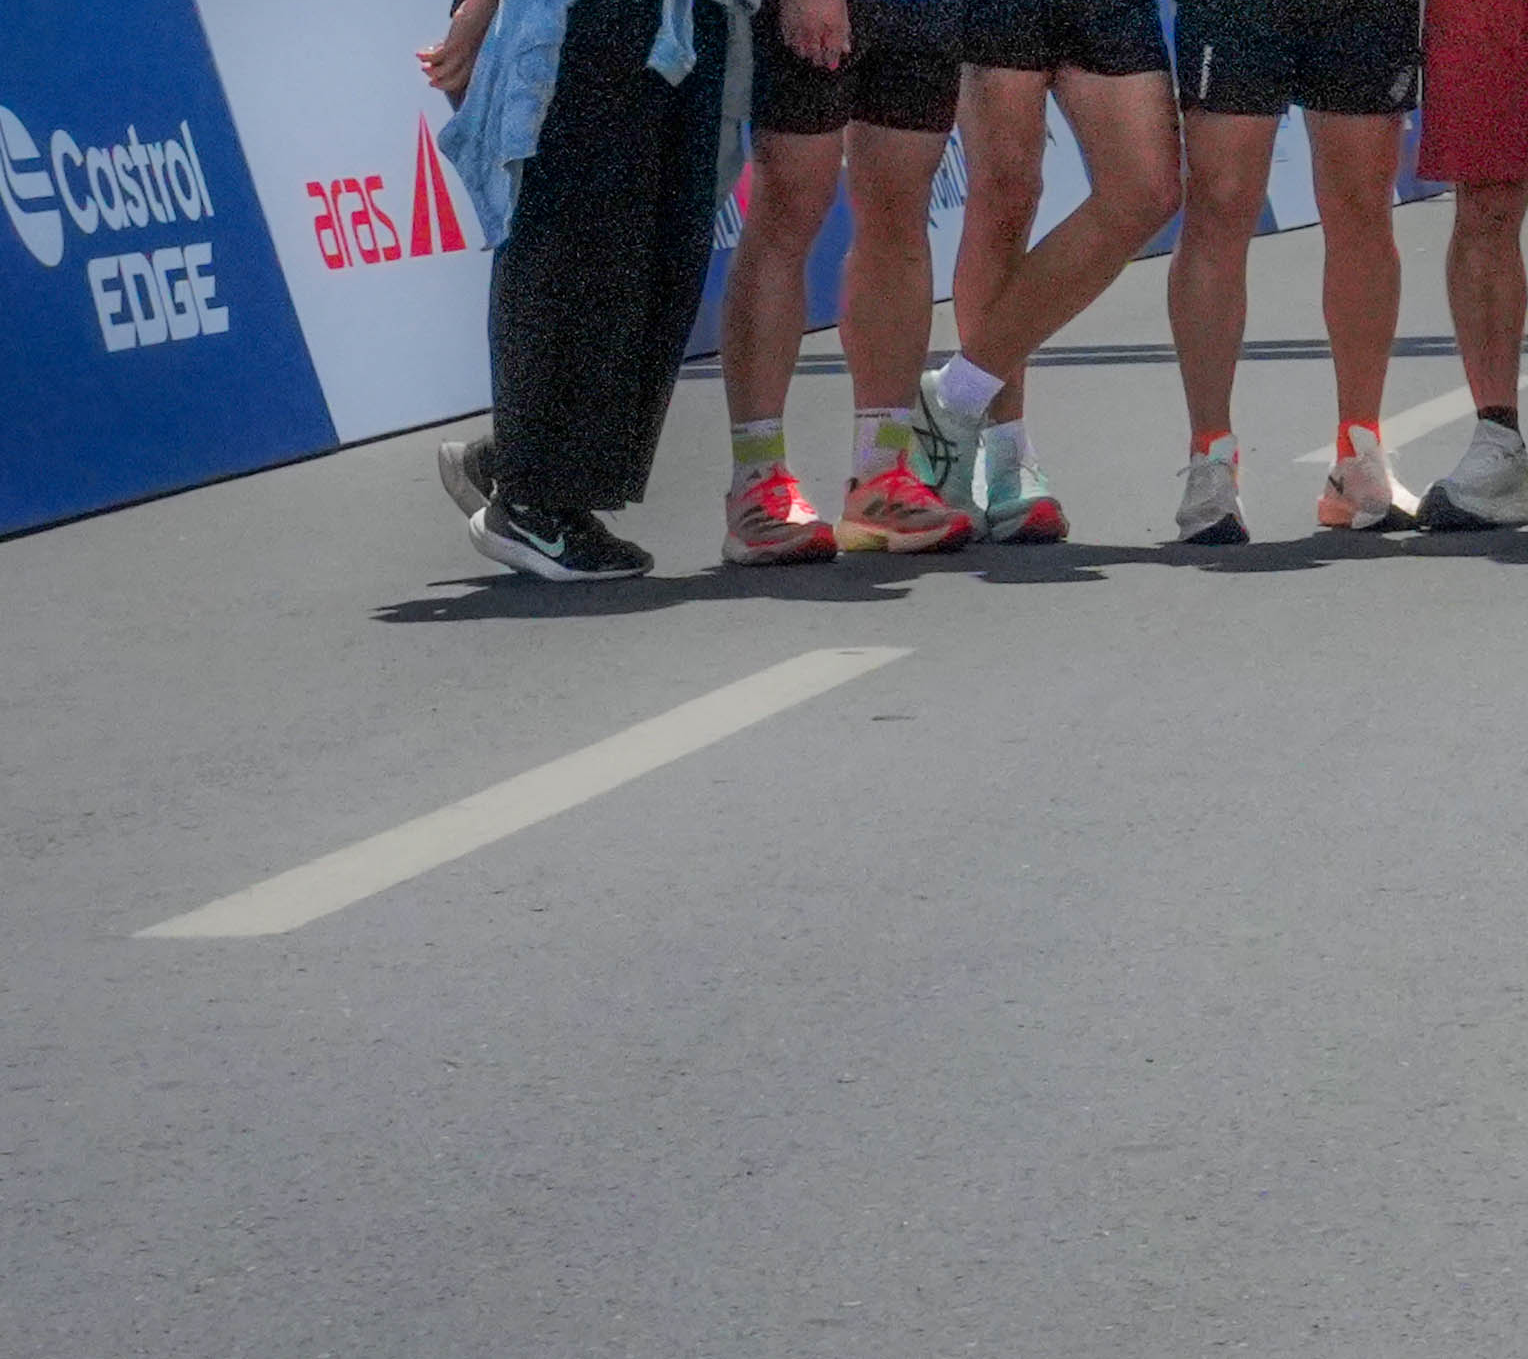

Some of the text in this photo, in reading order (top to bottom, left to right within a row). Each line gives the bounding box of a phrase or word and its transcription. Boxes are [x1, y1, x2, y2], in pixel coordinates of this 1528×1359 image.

[50, 119, 214, 235] Castrol
[306, 174, 402, 270] aras
[88, 242, 229, 353] EDGE
